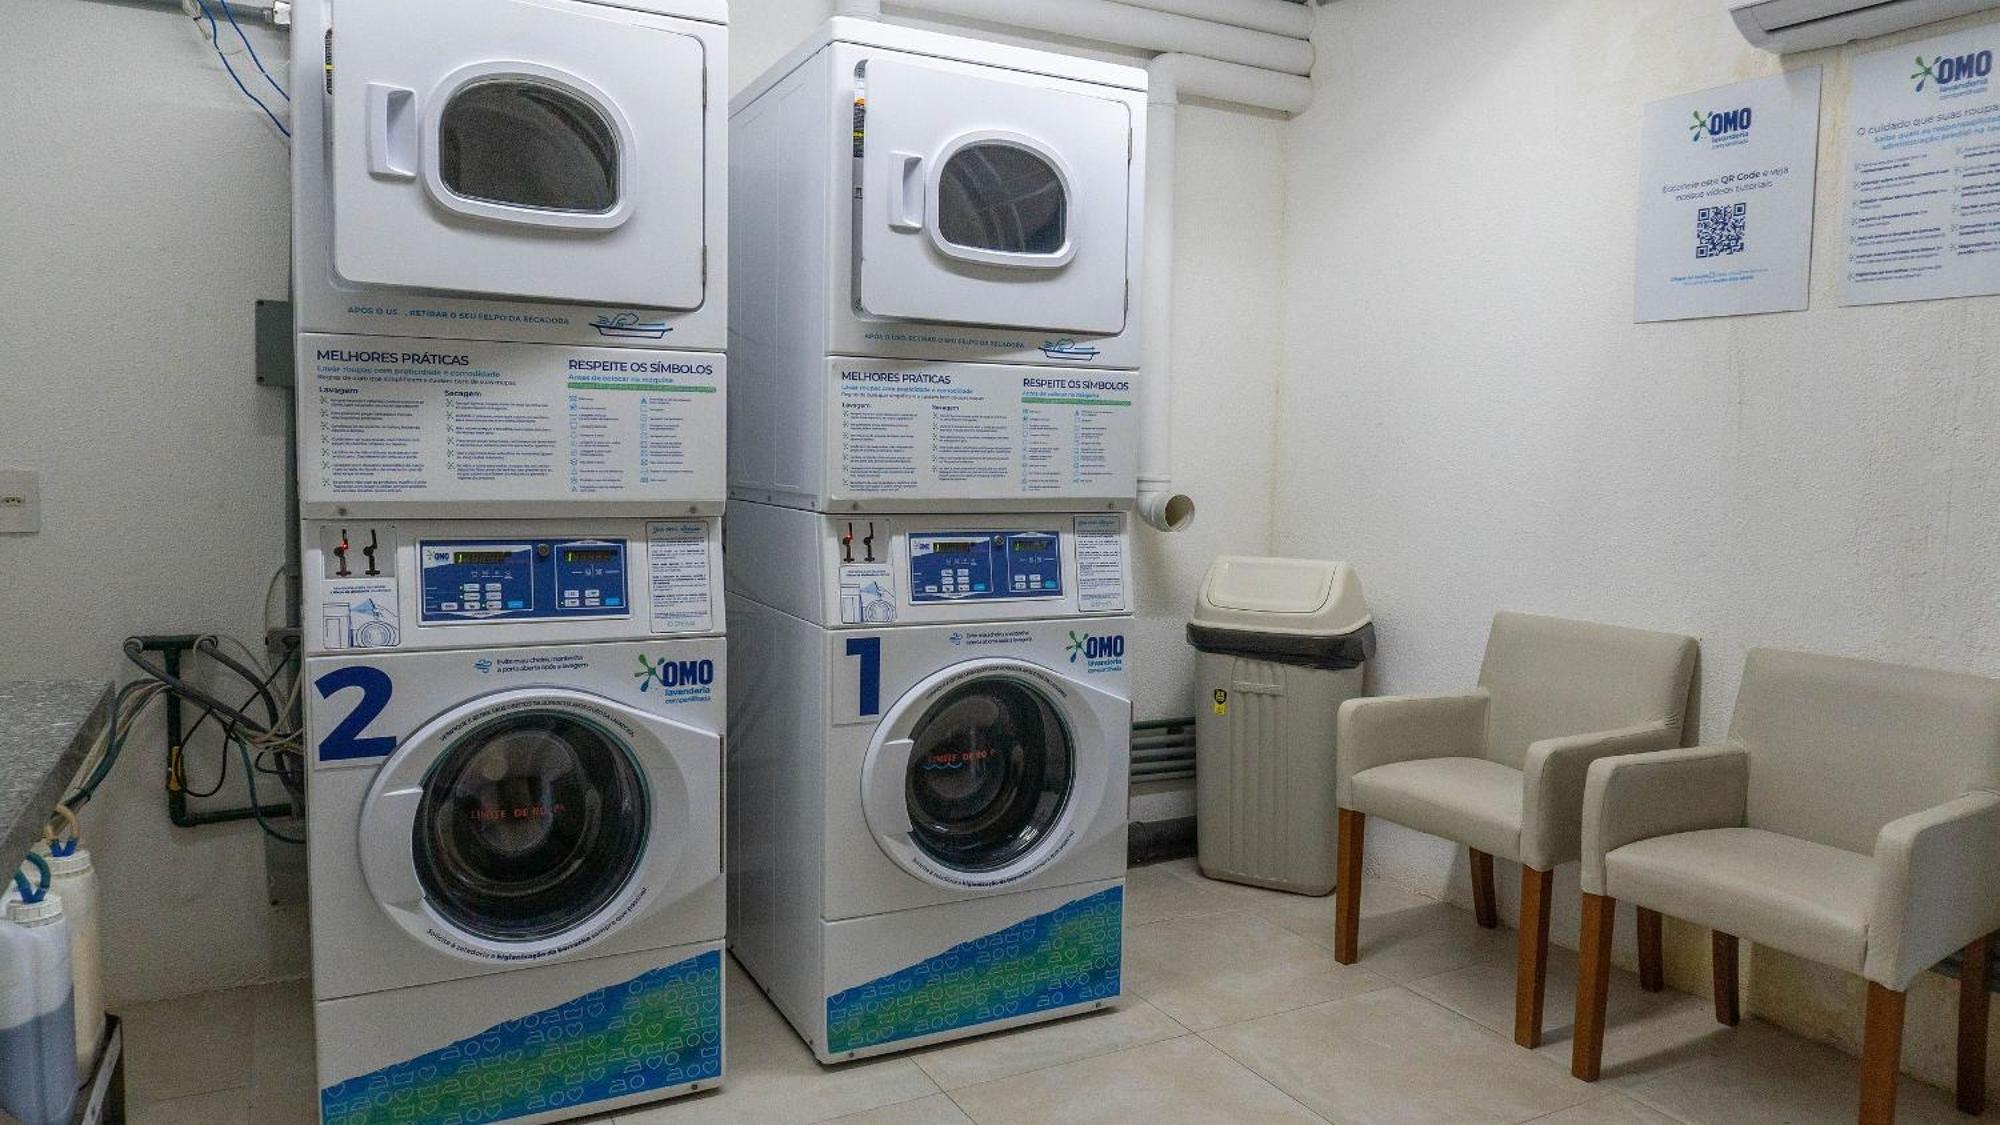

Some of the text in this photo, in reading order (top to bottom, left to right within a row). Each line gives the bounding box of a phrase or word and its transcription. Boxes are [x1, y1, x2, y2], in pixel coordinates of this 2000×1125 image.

[1937, 49, 1992, 84] OMO
[1710, 107, 1751, 135] OMO
[1857, 127, 1865, 136] O
[1868, 121, 1910, 134] cuidado
[1912, 117, 1934, 127] que
[1937, 111, 1962, 121] suas
[1721, 175, 1735, 184] QR
[1737, 170, 1761, 181] Code
[376, 307, 384, 315] O
[409, 309, 448, 318] RETIRAR
[317, 350, 469, 366] MELHORES PRÁTICAS
[568, 359, 713, 375] RESPEITE OS SÍMBOLOS
[841, 371, 952, 385] MELHORES PRÁTICAS
[1023, 378, 1129, 391] RESPEITE OS SÍMBOLOS
[319, 386, 482, 398] Lavagem Secagem
[434, 552, 449, 561] OMO
[1086, 635, 1125, 659] OMO
[662, 659, 714, 687] OMO
[846, 637, 881, 716] 1
[315, 666, 397, 761] 2
